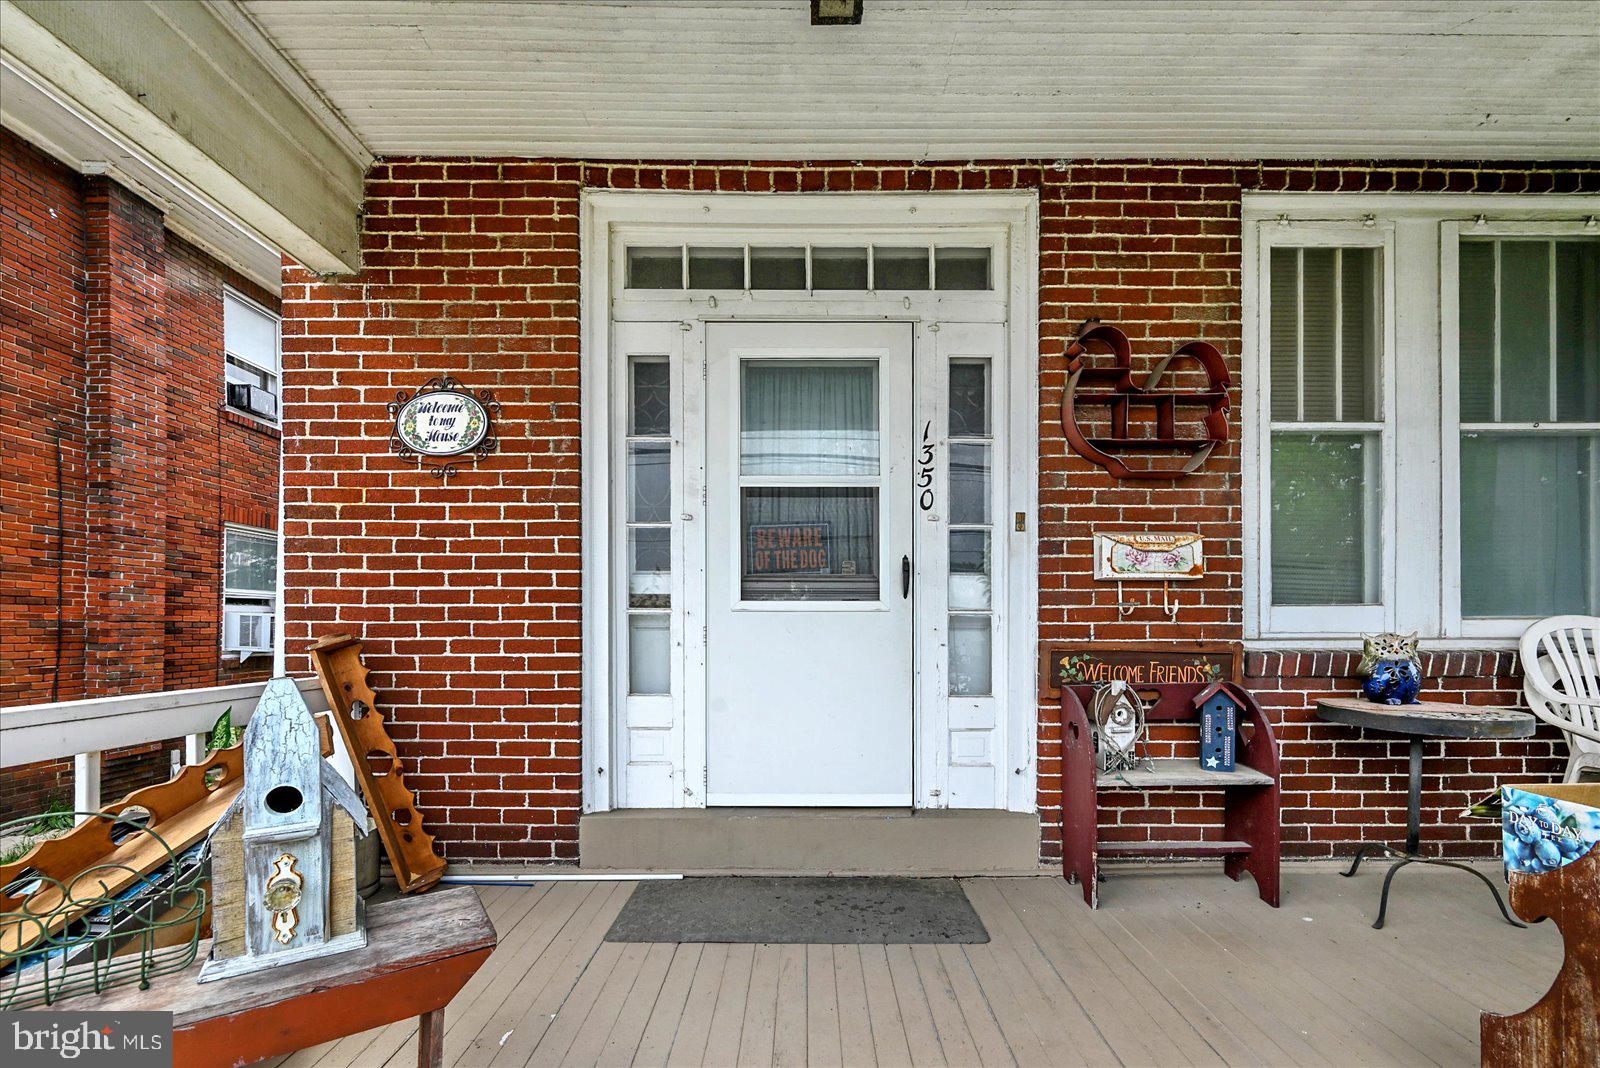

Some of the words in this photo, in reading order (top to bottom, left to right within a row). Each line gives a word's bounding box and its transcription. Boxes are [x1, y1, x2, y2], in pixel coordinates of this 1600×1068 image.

[418, 402, 464, 413] Welcome
[428, 415, 438, 427] to
[440, 417, 456, 430] my
[425, 430, 459, 442] House
[917, 420, 935, 511] 1350
[756, 527, 823, 548] BEWARE
[755, 551, 771, 570] OF
[774, 550, 798, 569] THE
[801, 549, 827, 569] DOG
[1076, 661, 1145, 683] WELCOME
[1150, 661, 1205, 683] FRIENDS
[1509, 811, 1538, 827] DAY
[1540, 821, 1549, 829] TO
[1551, 822, 1582, 841] DAY
